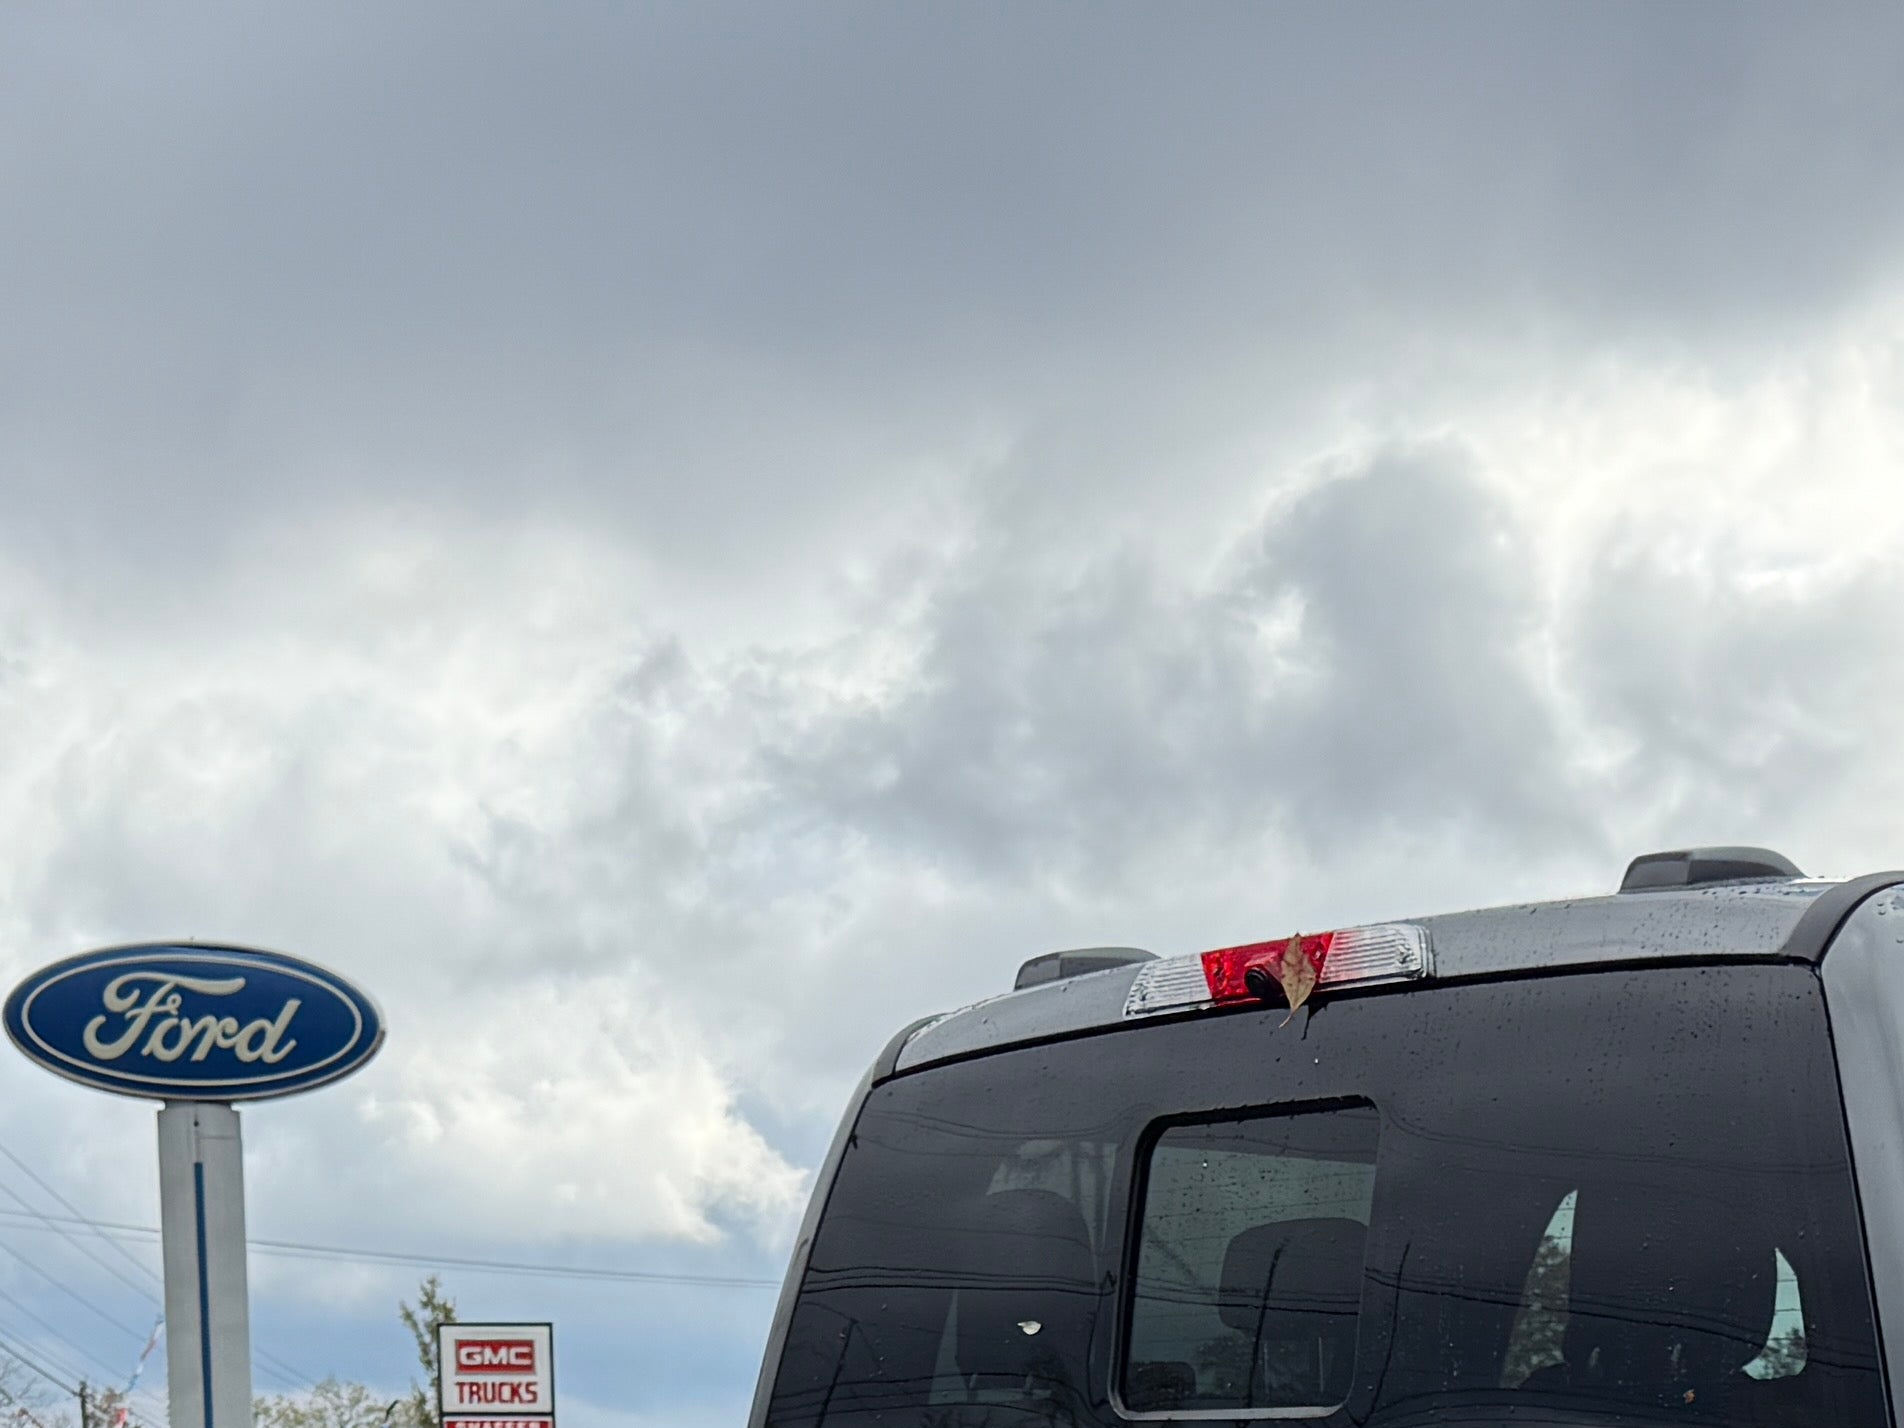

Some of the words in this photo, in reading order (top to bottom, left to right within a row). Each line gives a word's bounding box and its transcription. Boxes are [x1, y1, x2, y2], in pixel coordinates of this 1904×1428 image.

[83, 971, 301, 1064] Ford
[459, 1346, 532, 1366] GMC
[455, 1382, 539, 1404] TRUCKS
